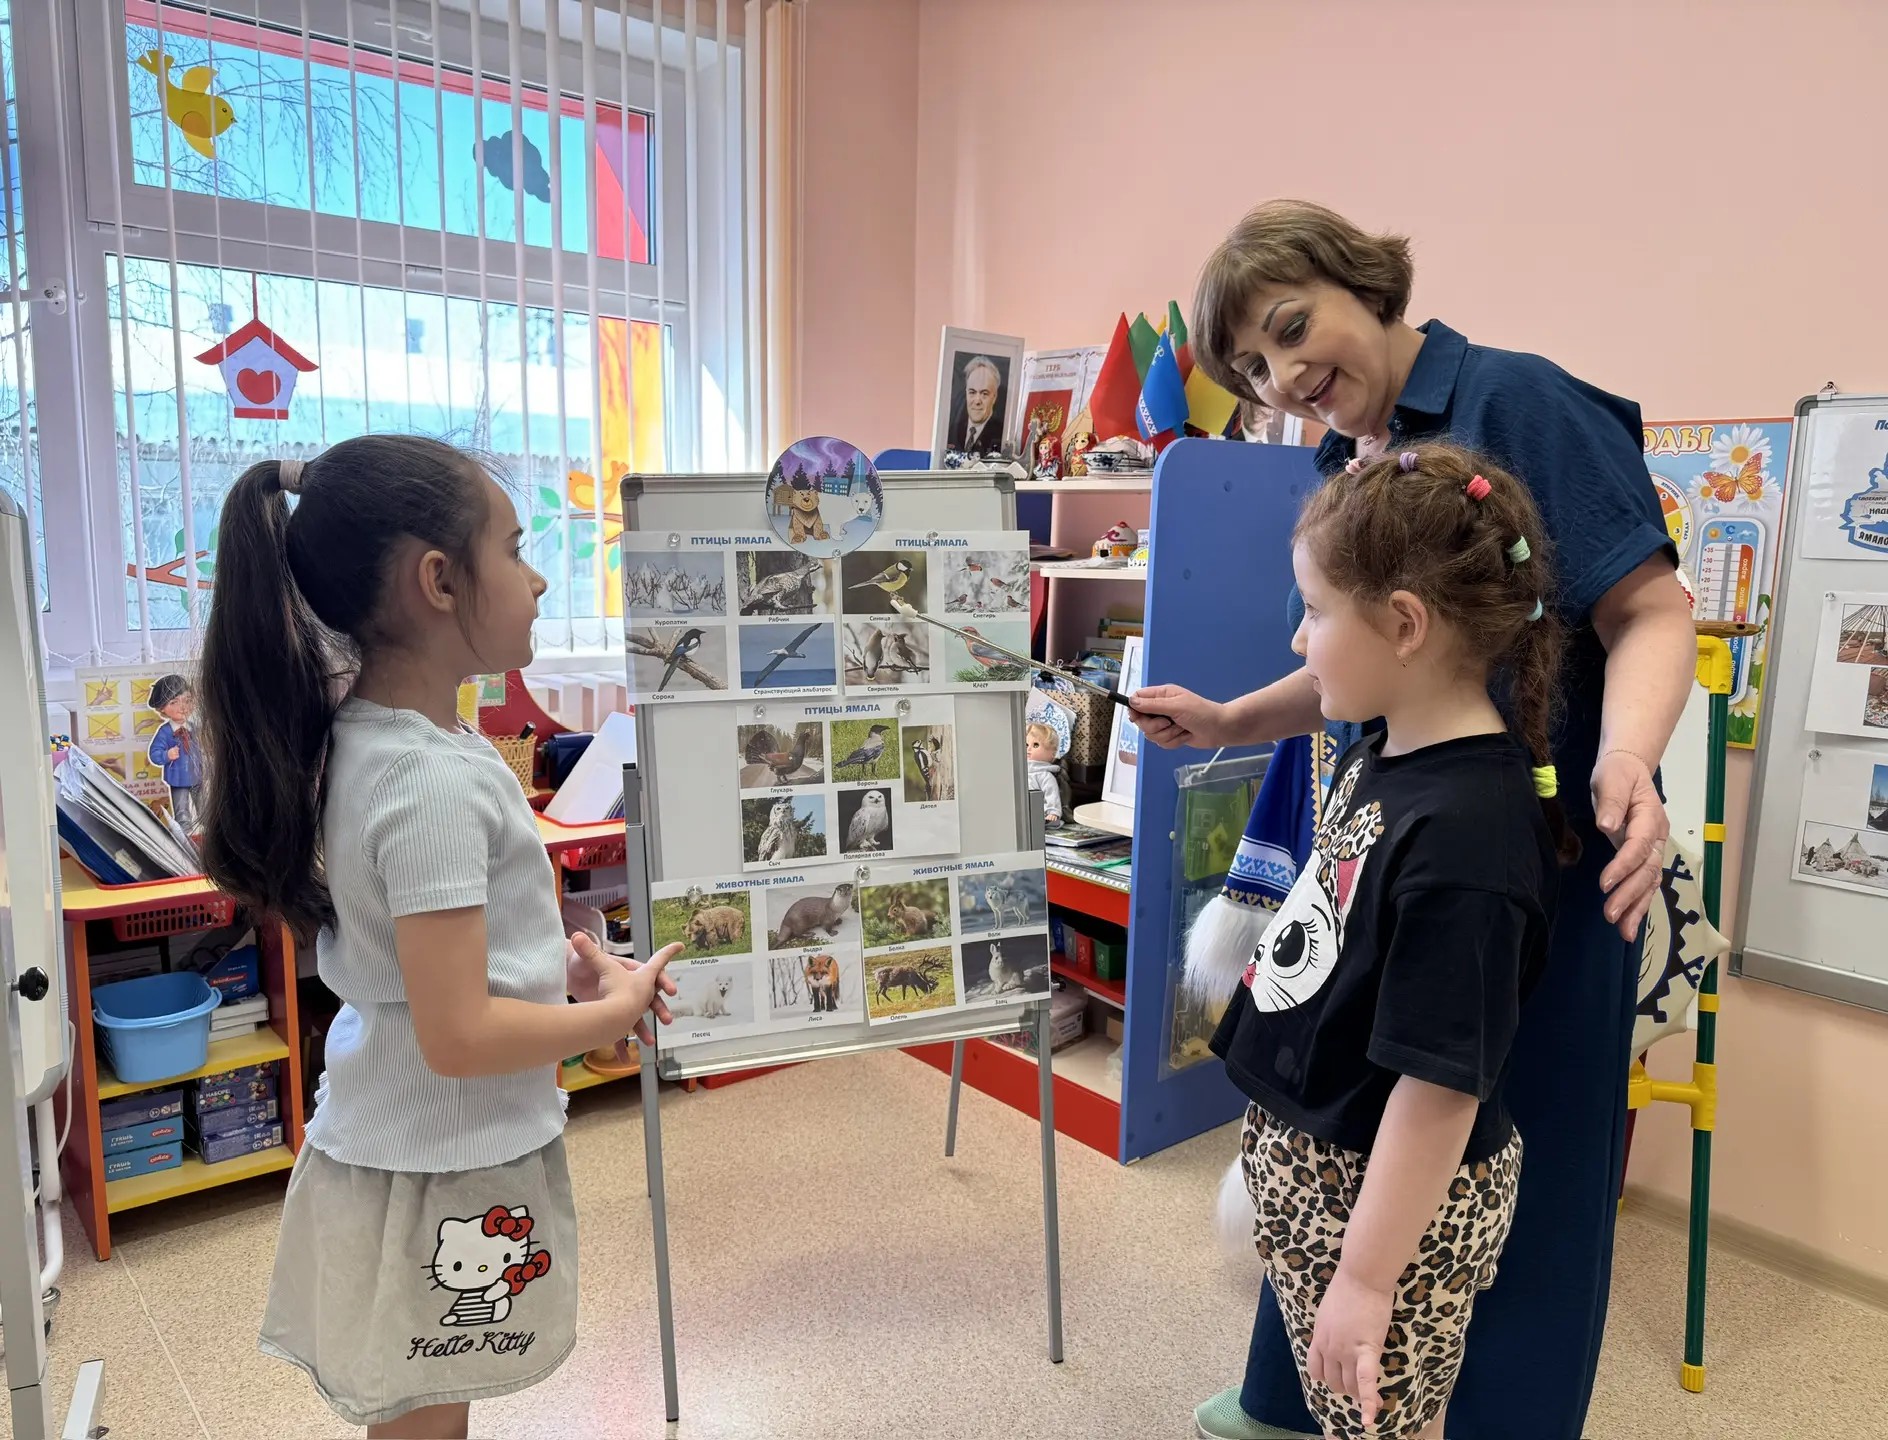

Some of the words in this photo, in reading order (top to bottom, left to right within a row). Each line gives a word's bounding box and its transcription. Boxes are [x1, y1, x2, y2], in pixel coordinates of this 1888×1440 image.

[691, 536, 732, 546] ПТИЦЫ
[734, 536, 773, 546] ЯМАЛА
[895, 538, 931, 547] ПТИЦЫ
[933, 538, 969, 547] ЯМАЛА
[655, 619, 688, 627] Куропатки
[753, 686, 801, 696] Странствующий
[652, 693, 675, 701] Сорока
[804, 705, 843, 716] ПТИЦЫ
[845, 704, 881, 714] ЯМАЛА
[913, 863, 963, 876] ЖИВОТНЫЕ
[964, 860, 995, 869] ЯМАЛА
[715, 877, 771, 890] ЖИВОТНЫЕ
[772, 875, 805, 885] ЯМАЛА
[406, 1333, 475, 1360] Hello
[475, 1331, 536, 1356] Kitty
